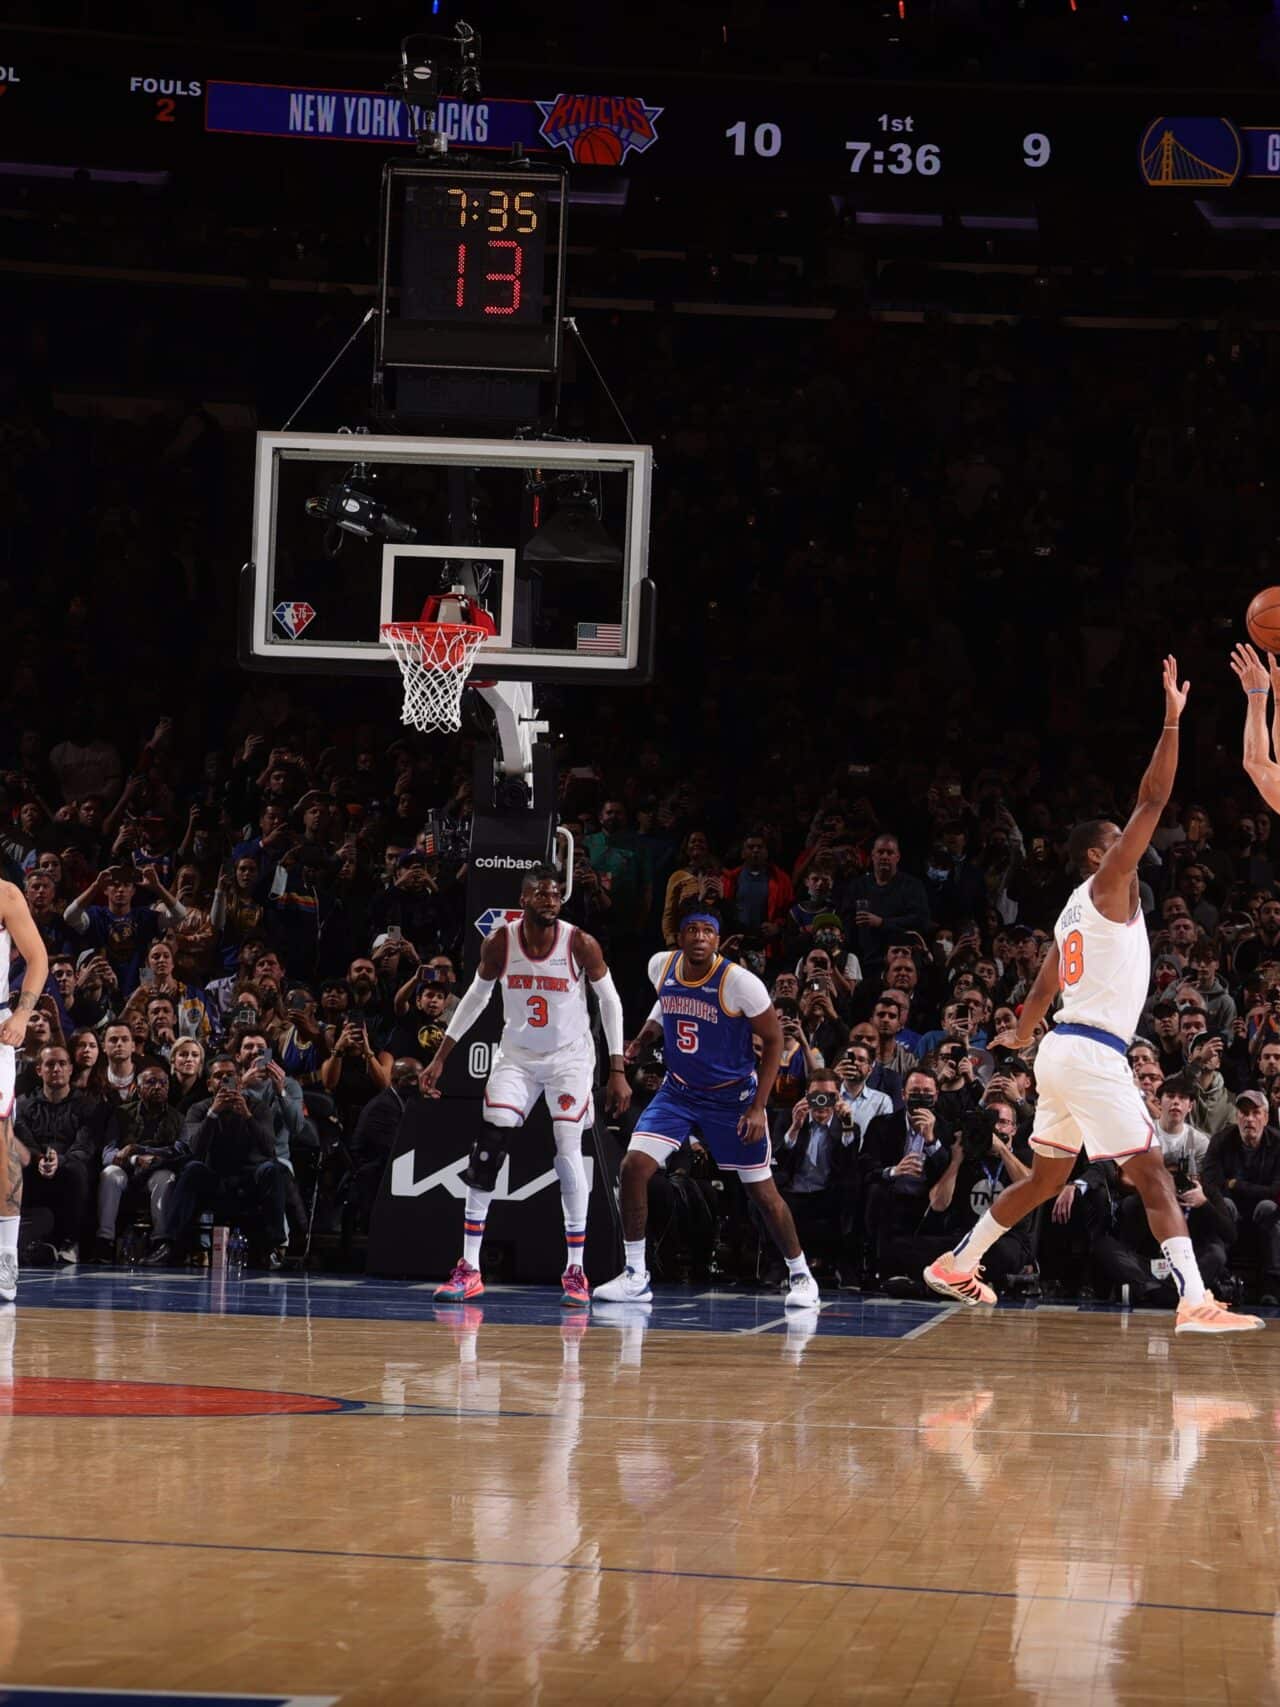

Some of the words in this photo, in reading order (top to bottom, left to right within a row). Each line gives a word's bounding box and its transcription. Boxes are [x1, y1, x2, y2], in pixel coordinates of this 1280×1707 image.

[130, 77, 201, 96] FOULS
[155, 98, 175, 122] 2
[289, 93, 336, 133] NEW
[344, 96, 400, 137] YORK
[544, 97, 651, 138] KNICKS
[877, 114, 914, 132] 1st
[726, 121, 782, 157] 10
[1023, 133, 1051, 167] 9
[845, 141, 942, 175] 7:36
[448, 189, 537, 233] 7:35
[455, 240, 522, 315] 13
[507, 974, 533, 989] NEW
[527, 996, 548, 1028] 3
[661, 996, 718, 1024] WARRIORS
[676, 1020, 699, 1054] 5
